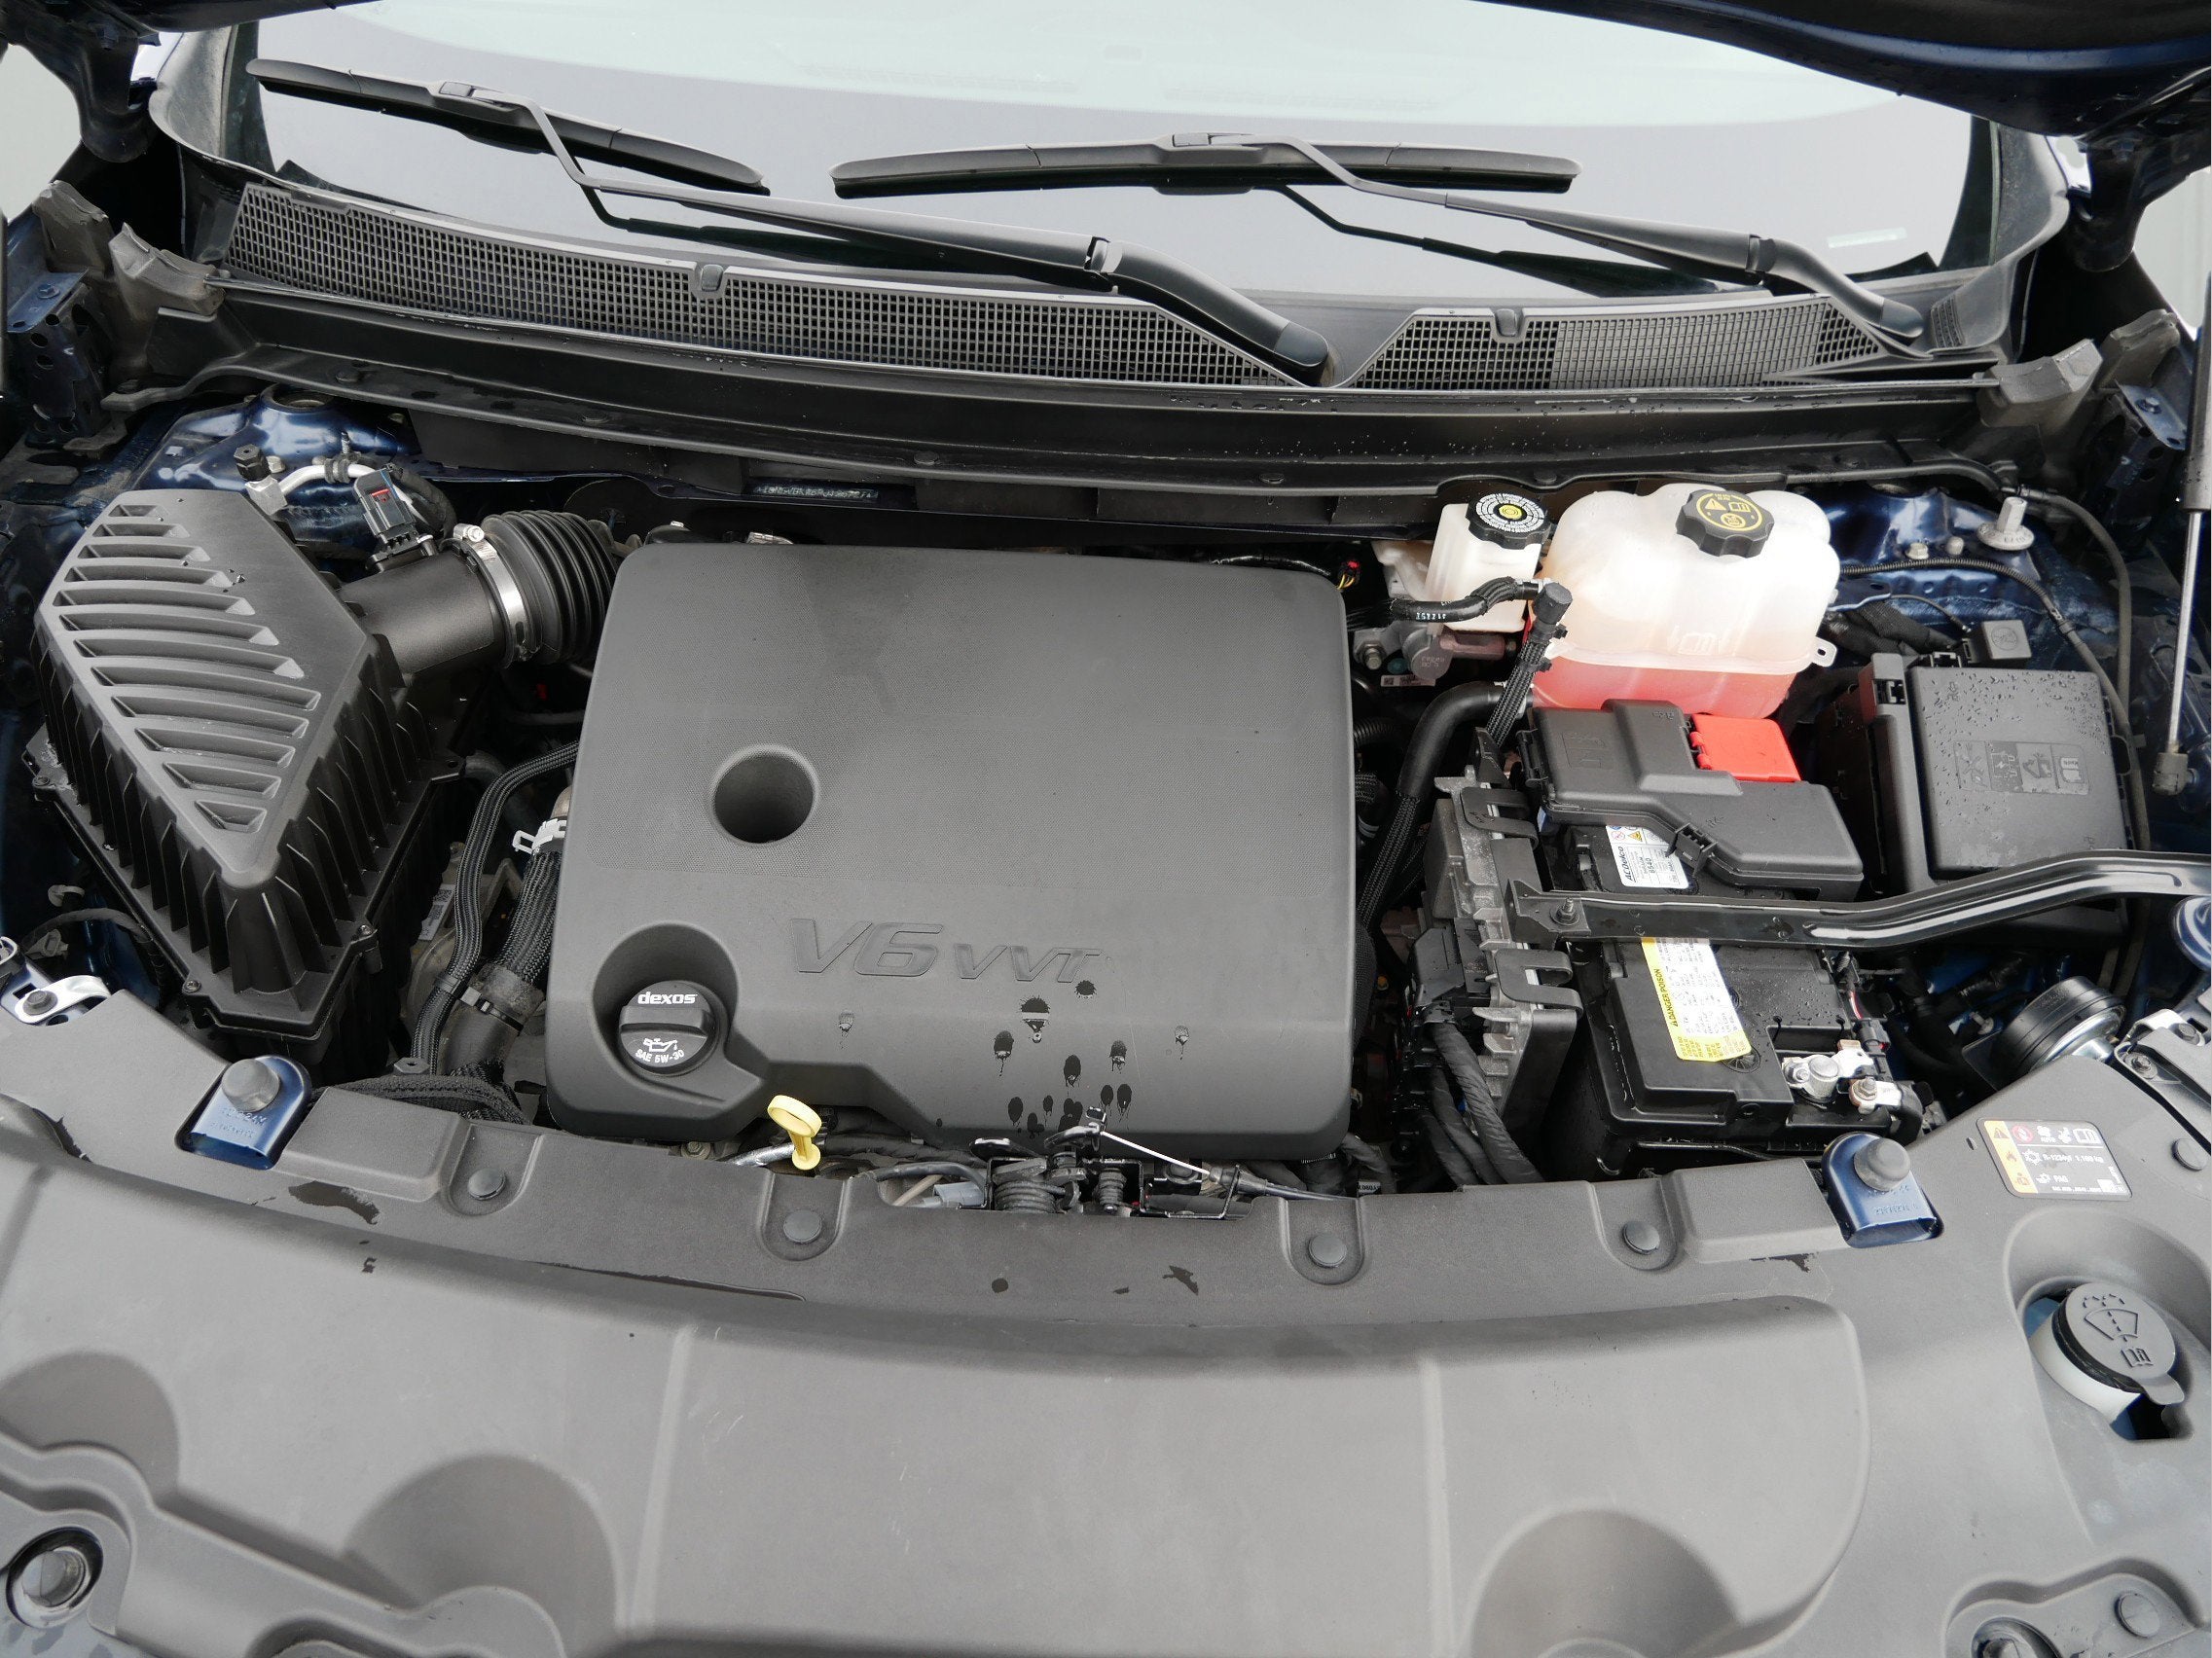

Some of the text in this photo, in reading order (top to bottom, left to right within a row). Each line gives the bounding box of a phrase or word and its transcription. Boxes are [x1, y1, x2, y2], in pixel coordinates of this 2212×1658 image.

[1618, 846, 1633, 882] ACDelco
[790, 918, 1105, 983] V6 VVT
[637, 991, 697, 1005] dexos
[635, 1049, 685, 1063] SAE 5W-30
